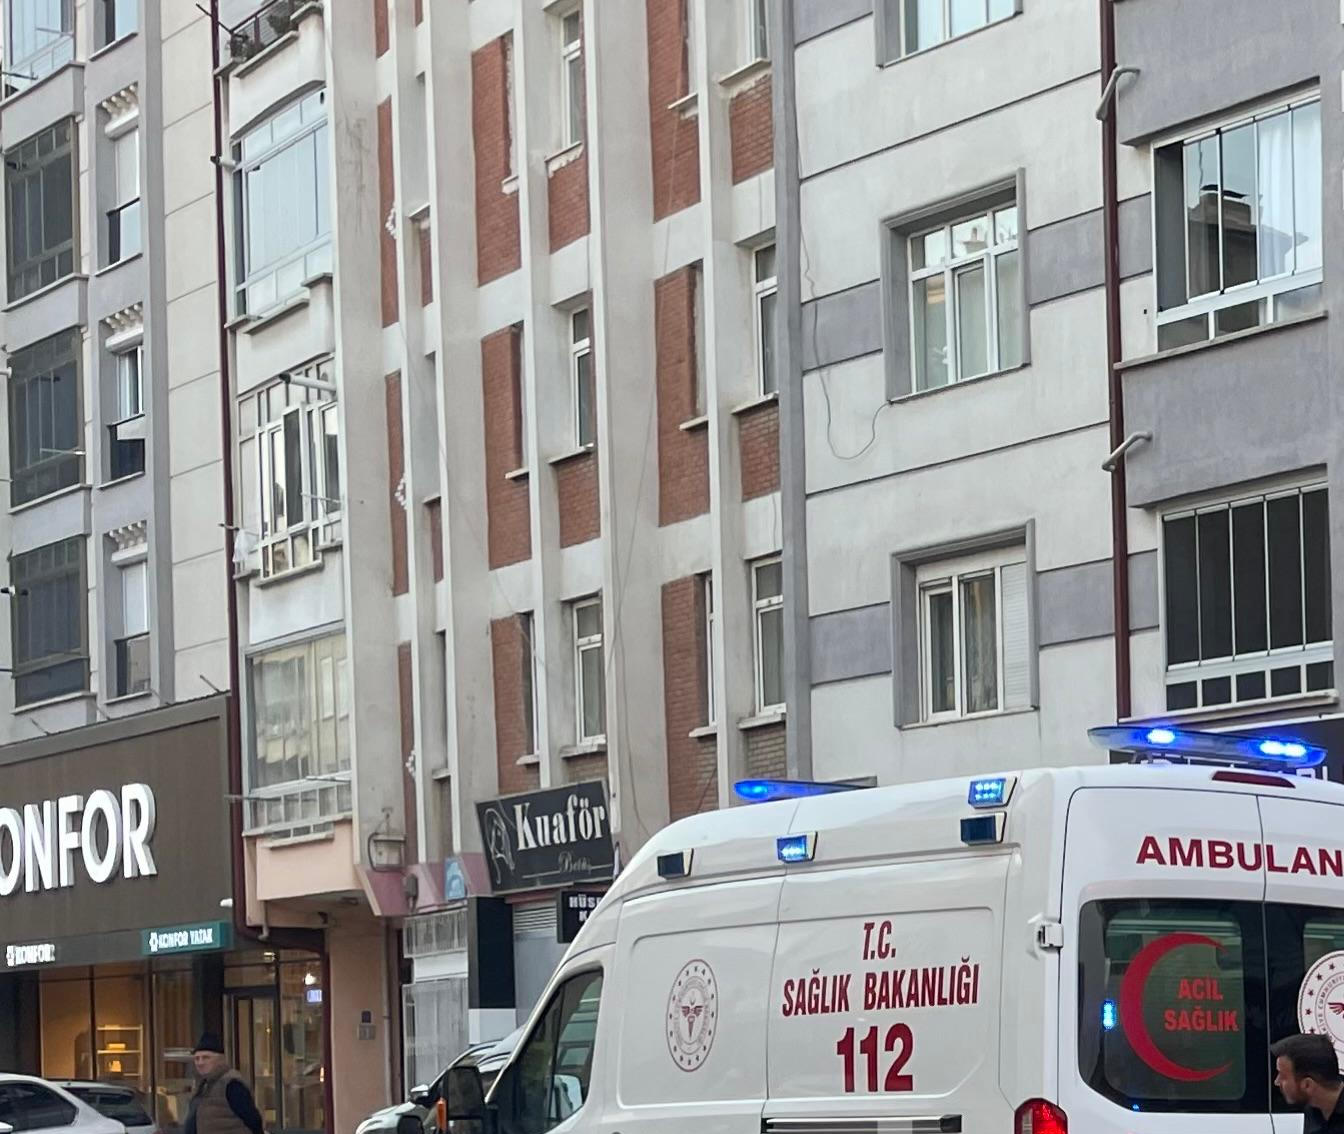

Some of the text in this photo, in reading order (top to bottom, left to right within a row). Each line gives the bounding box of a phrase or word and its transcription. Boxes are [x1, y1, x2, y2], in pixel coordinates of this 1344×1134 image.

[0, 783, 157, 896] ONFOR
[514, 794, 605, 850] Kuaför
[863, 920, 896, 960] T.C.
[782, 954, 980, 1017] SAĞLIK BAKANLIĞI
[1164, 1006, 1239, 1032] SAĞLIK
[837, 1023, 913, 1093] 112
